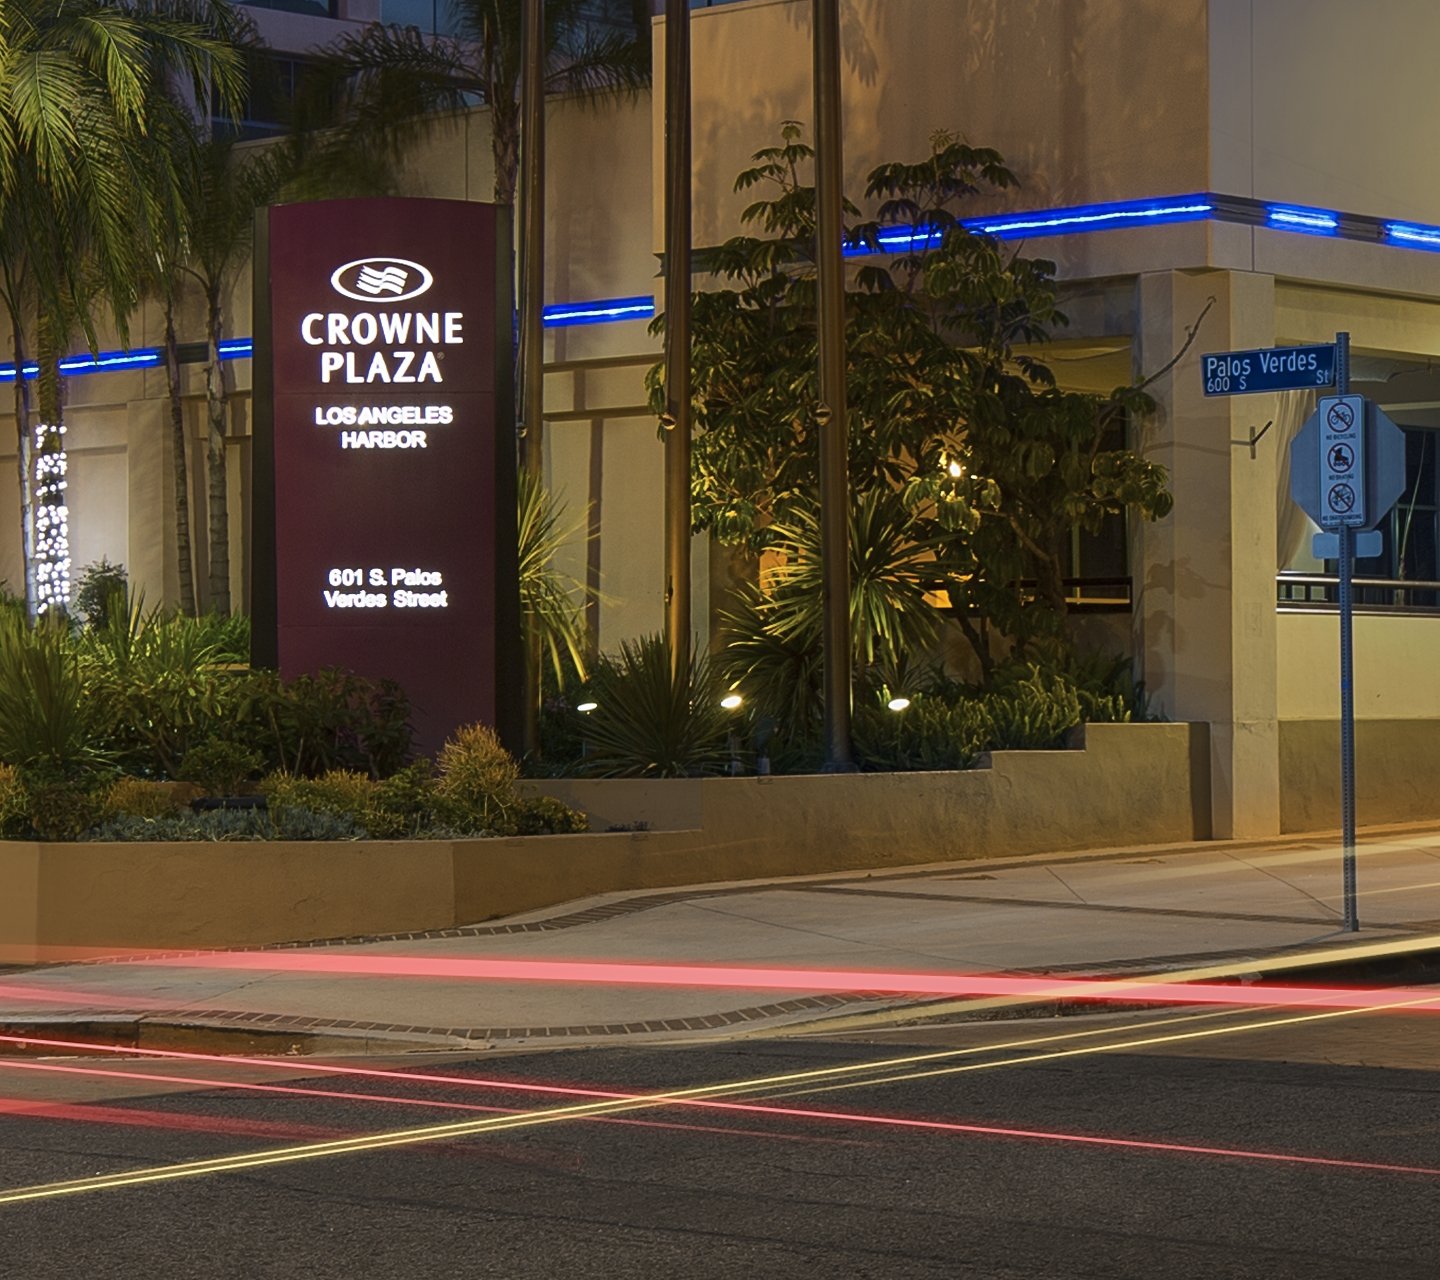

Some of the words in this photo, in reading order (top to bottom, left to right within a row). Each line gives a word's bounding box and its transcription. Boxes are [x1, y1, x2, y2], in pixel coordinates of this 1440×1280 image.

[301, 312, 464, 346] CROWNE
[321, 351, 444, 384] PLAZA
[1207, 356, 1251, 378] Palos
[1260, 351, 1317, 374] Verdes
[1207, 376, 1230, 392] 600
[1239, 376, 1247, 390] S
[1316, 369, 1329, 384] St
[316, 406, 359, 425] LOS
[357, 406, 454, 426] ANGELES
[341, 431, 427, 449] HARBOR
[328, 568, 363, 586] 601
[369, 568, 388, 586] S.
[391, 568, 443, 586] Palos
[323, 590, 387, 608] Verdes
[393, 589, 448, 608] Street
